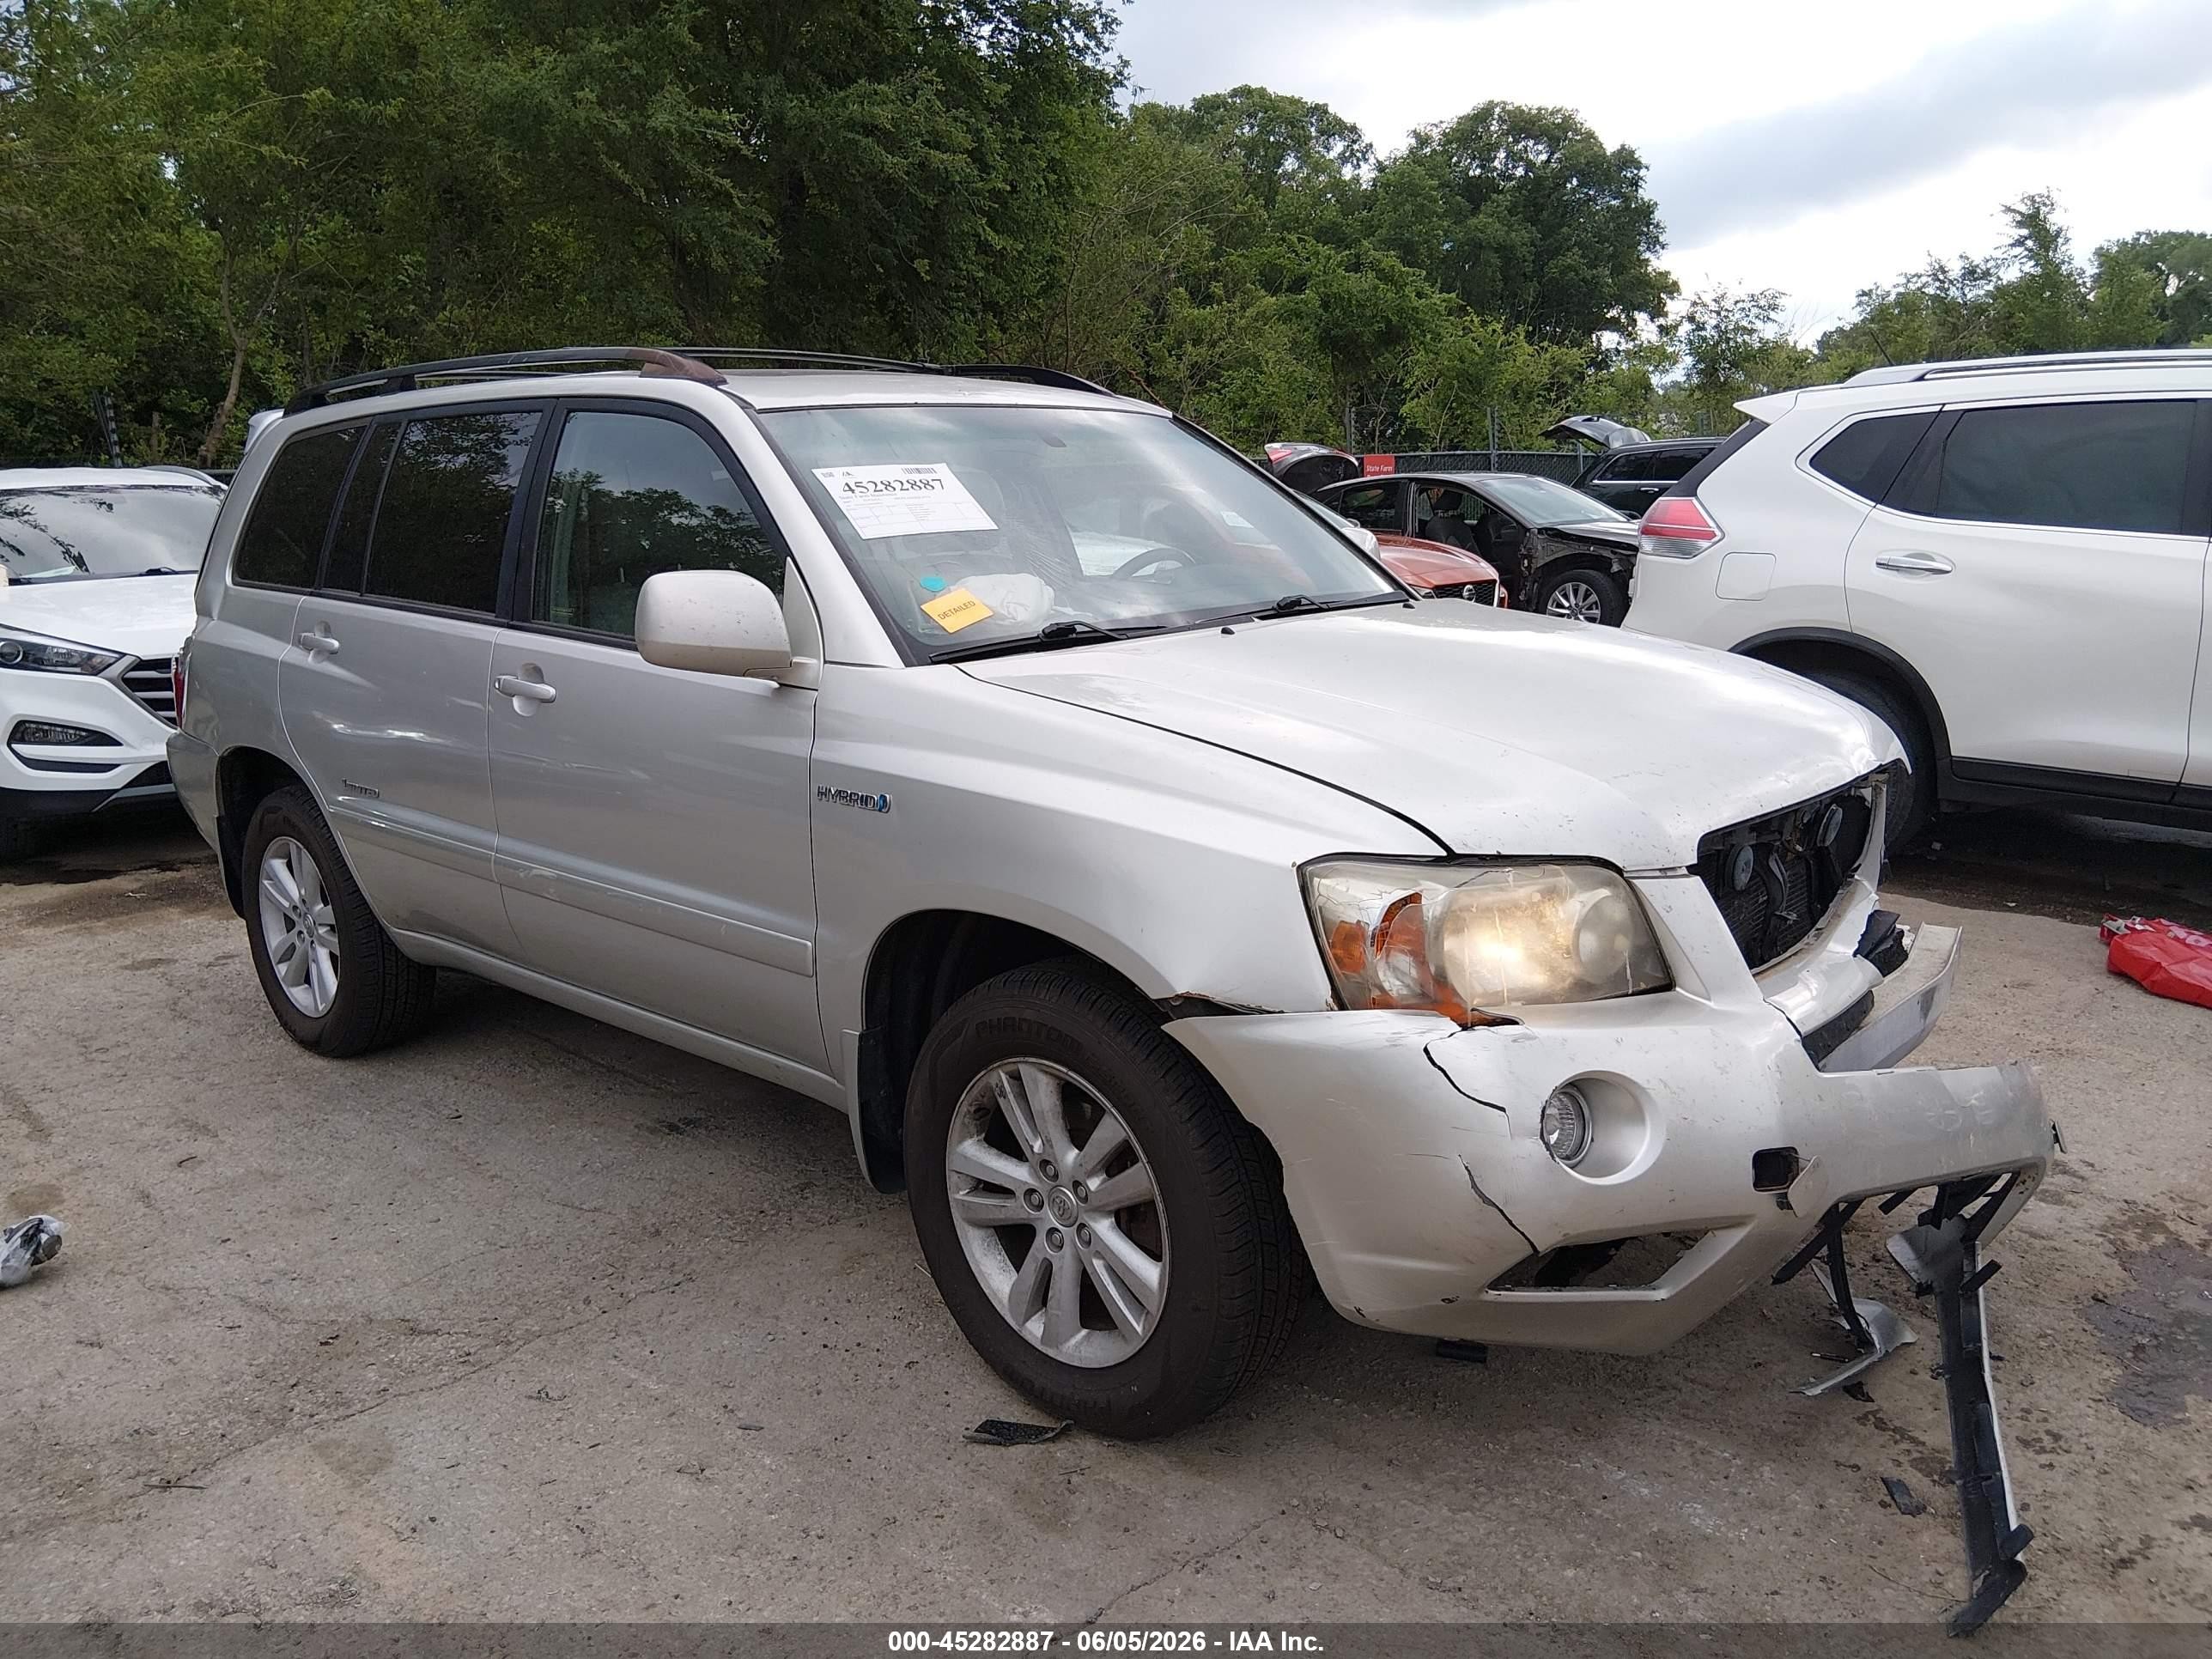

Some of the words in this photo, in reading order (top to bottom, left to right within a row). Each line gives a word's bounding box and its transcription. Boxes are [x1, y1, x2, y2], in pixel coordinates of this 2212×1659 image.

[842, 478, 945, 495] 45282887
[937, 599, 976, 620] DETAILED
[817, 785, 877, 809] HYBRID
